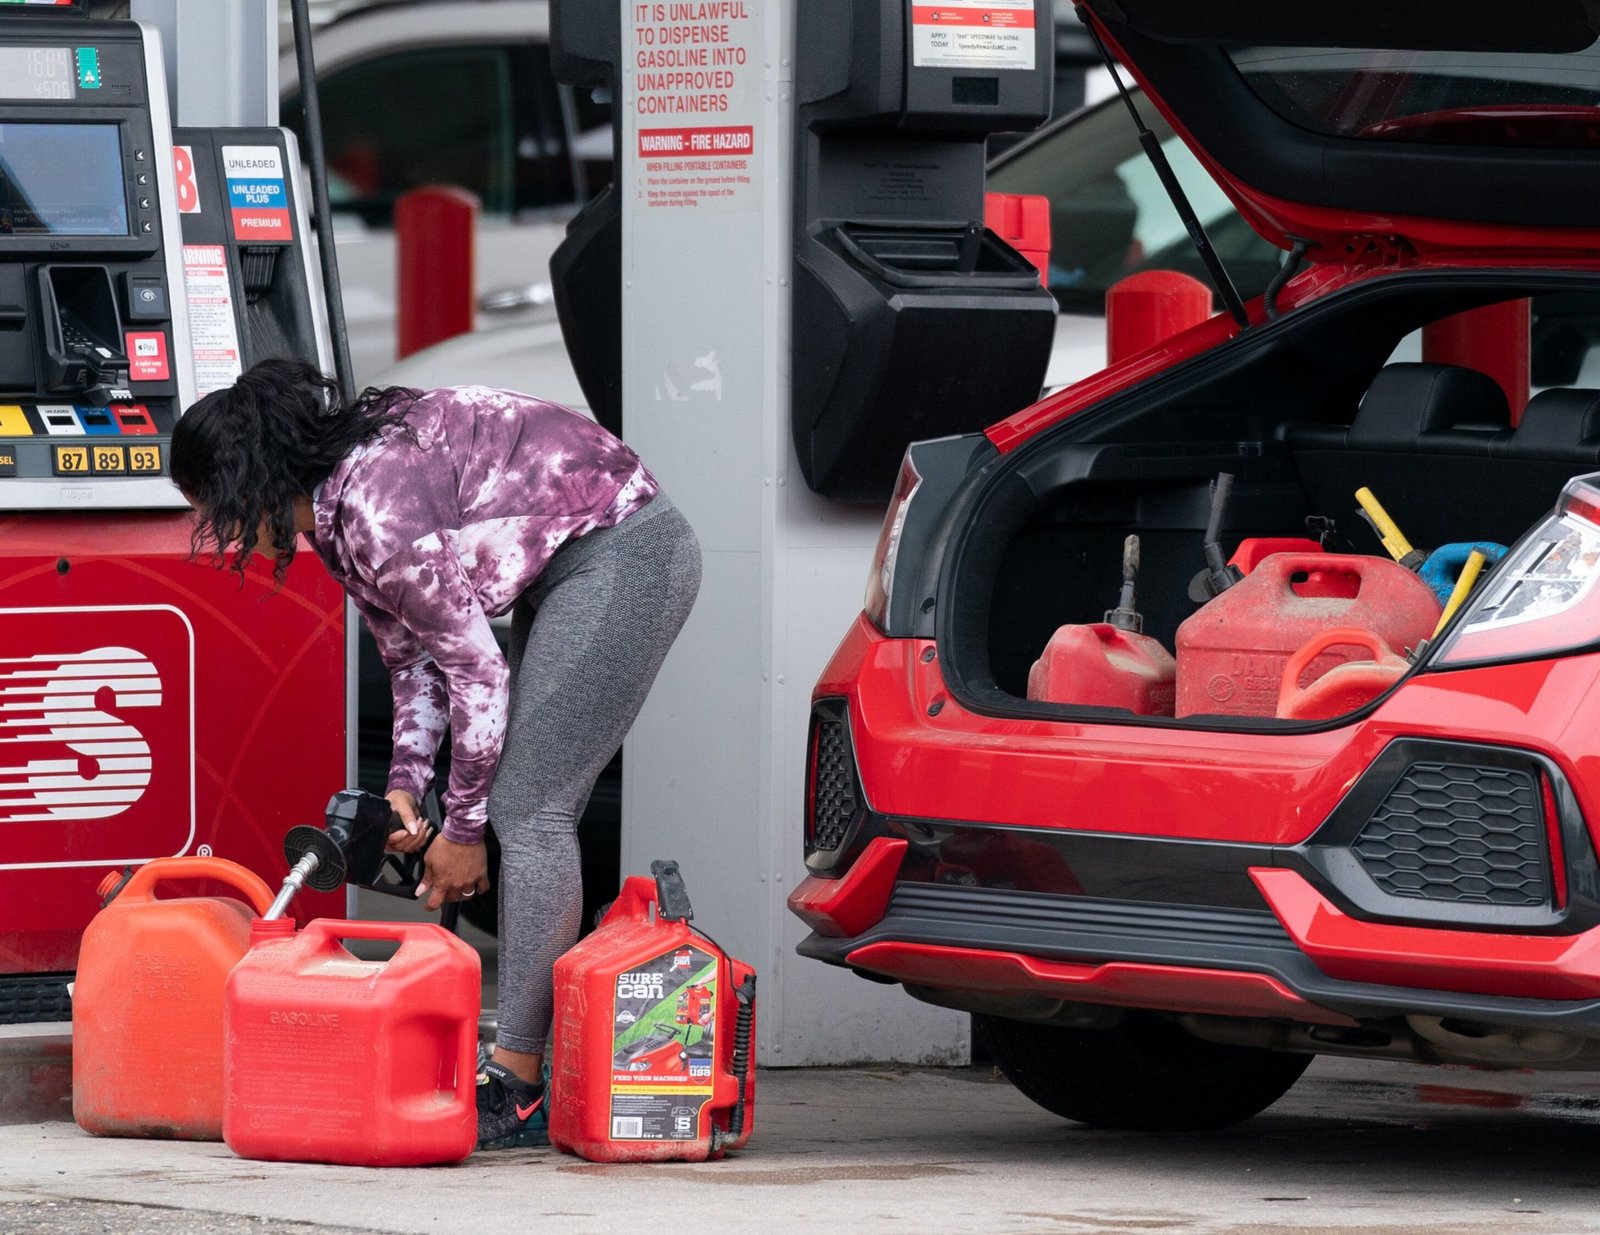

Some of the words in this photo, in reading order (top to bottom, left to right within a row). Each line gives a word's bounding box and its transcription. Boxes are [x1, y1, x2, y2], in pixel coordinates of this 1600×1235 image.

[636, 5, 648, 22] IT
[653, 4, 664, 22] IS
[670, 2, 748, 20] UNLAWFUL
[636, 28, 654, 45] TO
[660, 25, 728, 44] DISPENSE
[637, 48, 707, 68] GASOLINE
[712, 47, 746, 66] INTO
[638, 71, 734, 91] UNAPPROVED
[638, 94, 728, 114] CONTAINERS
[641, 135, 683, 151] WARNING
[691, 134, 712, 150] FIRE
[713, 133, 750, 149] HAZARD
[229, 160, 275, 168] UNLEADED
[646, 163, 662, 172] WHEN
[663, 162, 684, 171] FILLING
[684, 161, 711, 170] PORTABLE
[712, 160, 747, 170] CONTAINERS
[172, 147, 197, 212] 8
[232, 185, 280, 194] UNLEADED
[246, 194, 269, 203] PLUS
[241, 218, 281, 228] PREMIUM
[182, 248, 223, 265] ARNING
[62, 453, 82, 469] 87
[99, 453, 119, 469] 89
[134, 453, 155, 469] 93
[0, 646, 162, 823] S
[618, 973, 663, 984] SURE
[270, 1011, 340, 1027] GASOLINE
[678, 1118, 691, 1129] 5
